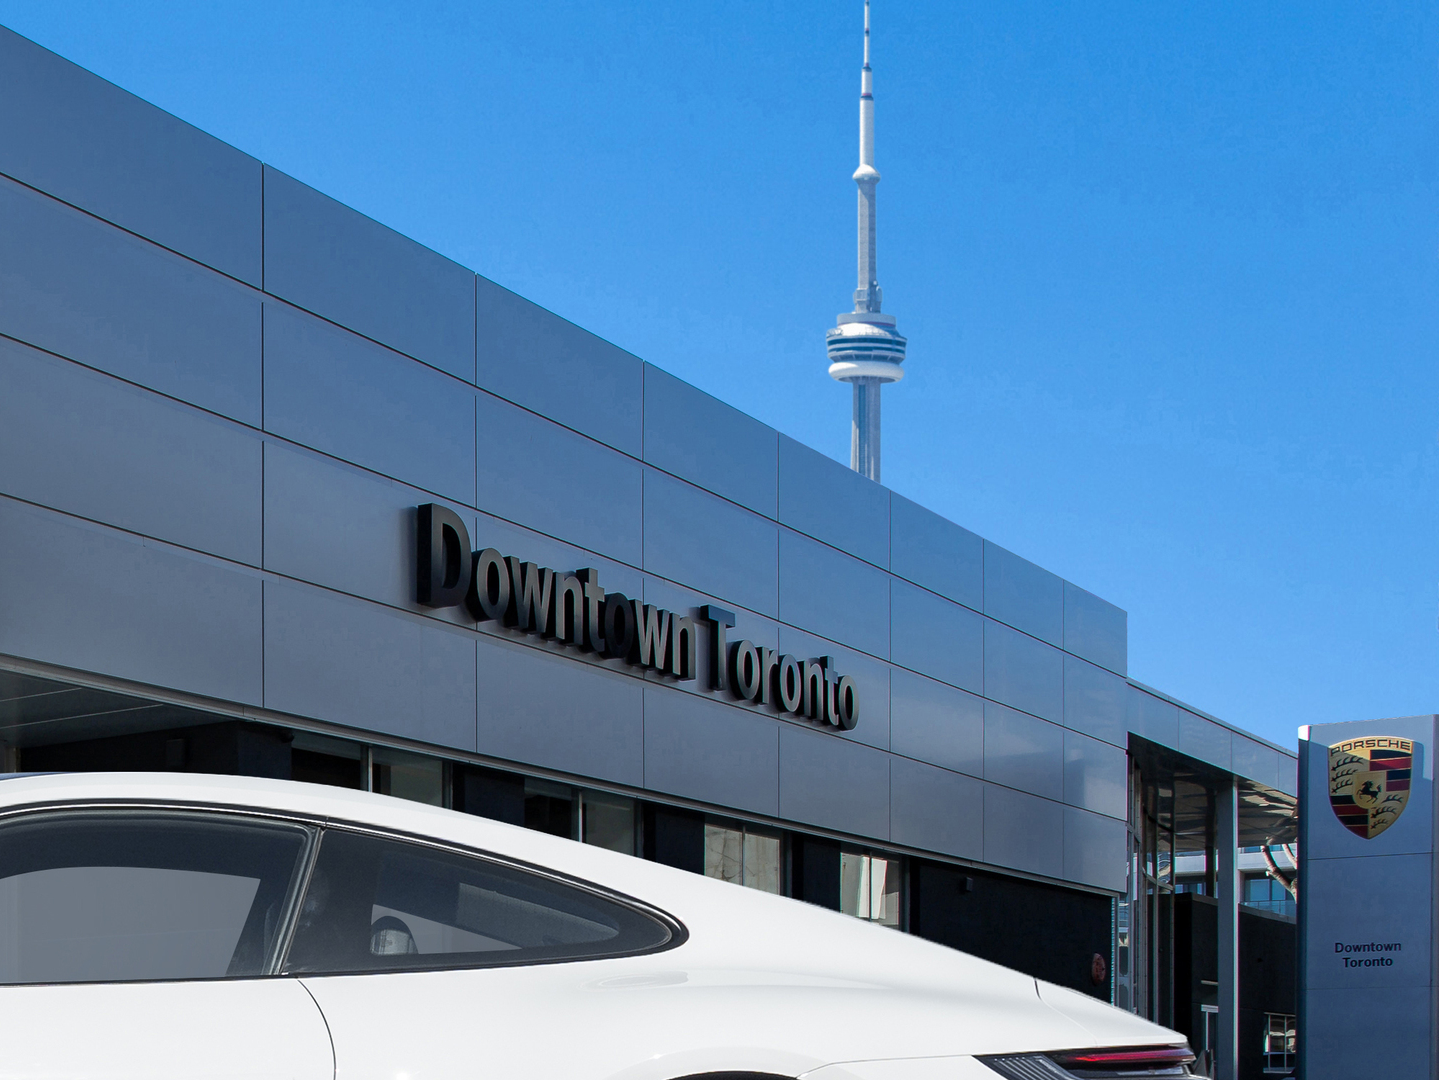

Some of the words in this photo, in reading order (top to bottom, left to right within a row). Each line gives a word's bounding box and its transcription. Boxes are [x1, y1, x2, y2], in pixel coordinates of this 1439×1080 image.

[417, 502, 696, 682] Downtown
[699, 604, 860, 731] Toronto
[1330, 739, 1411, 757] PORSCHE
[1334, 942, 1402, 954] Downtown
[1342, 956, 1394, 968] Toronto
